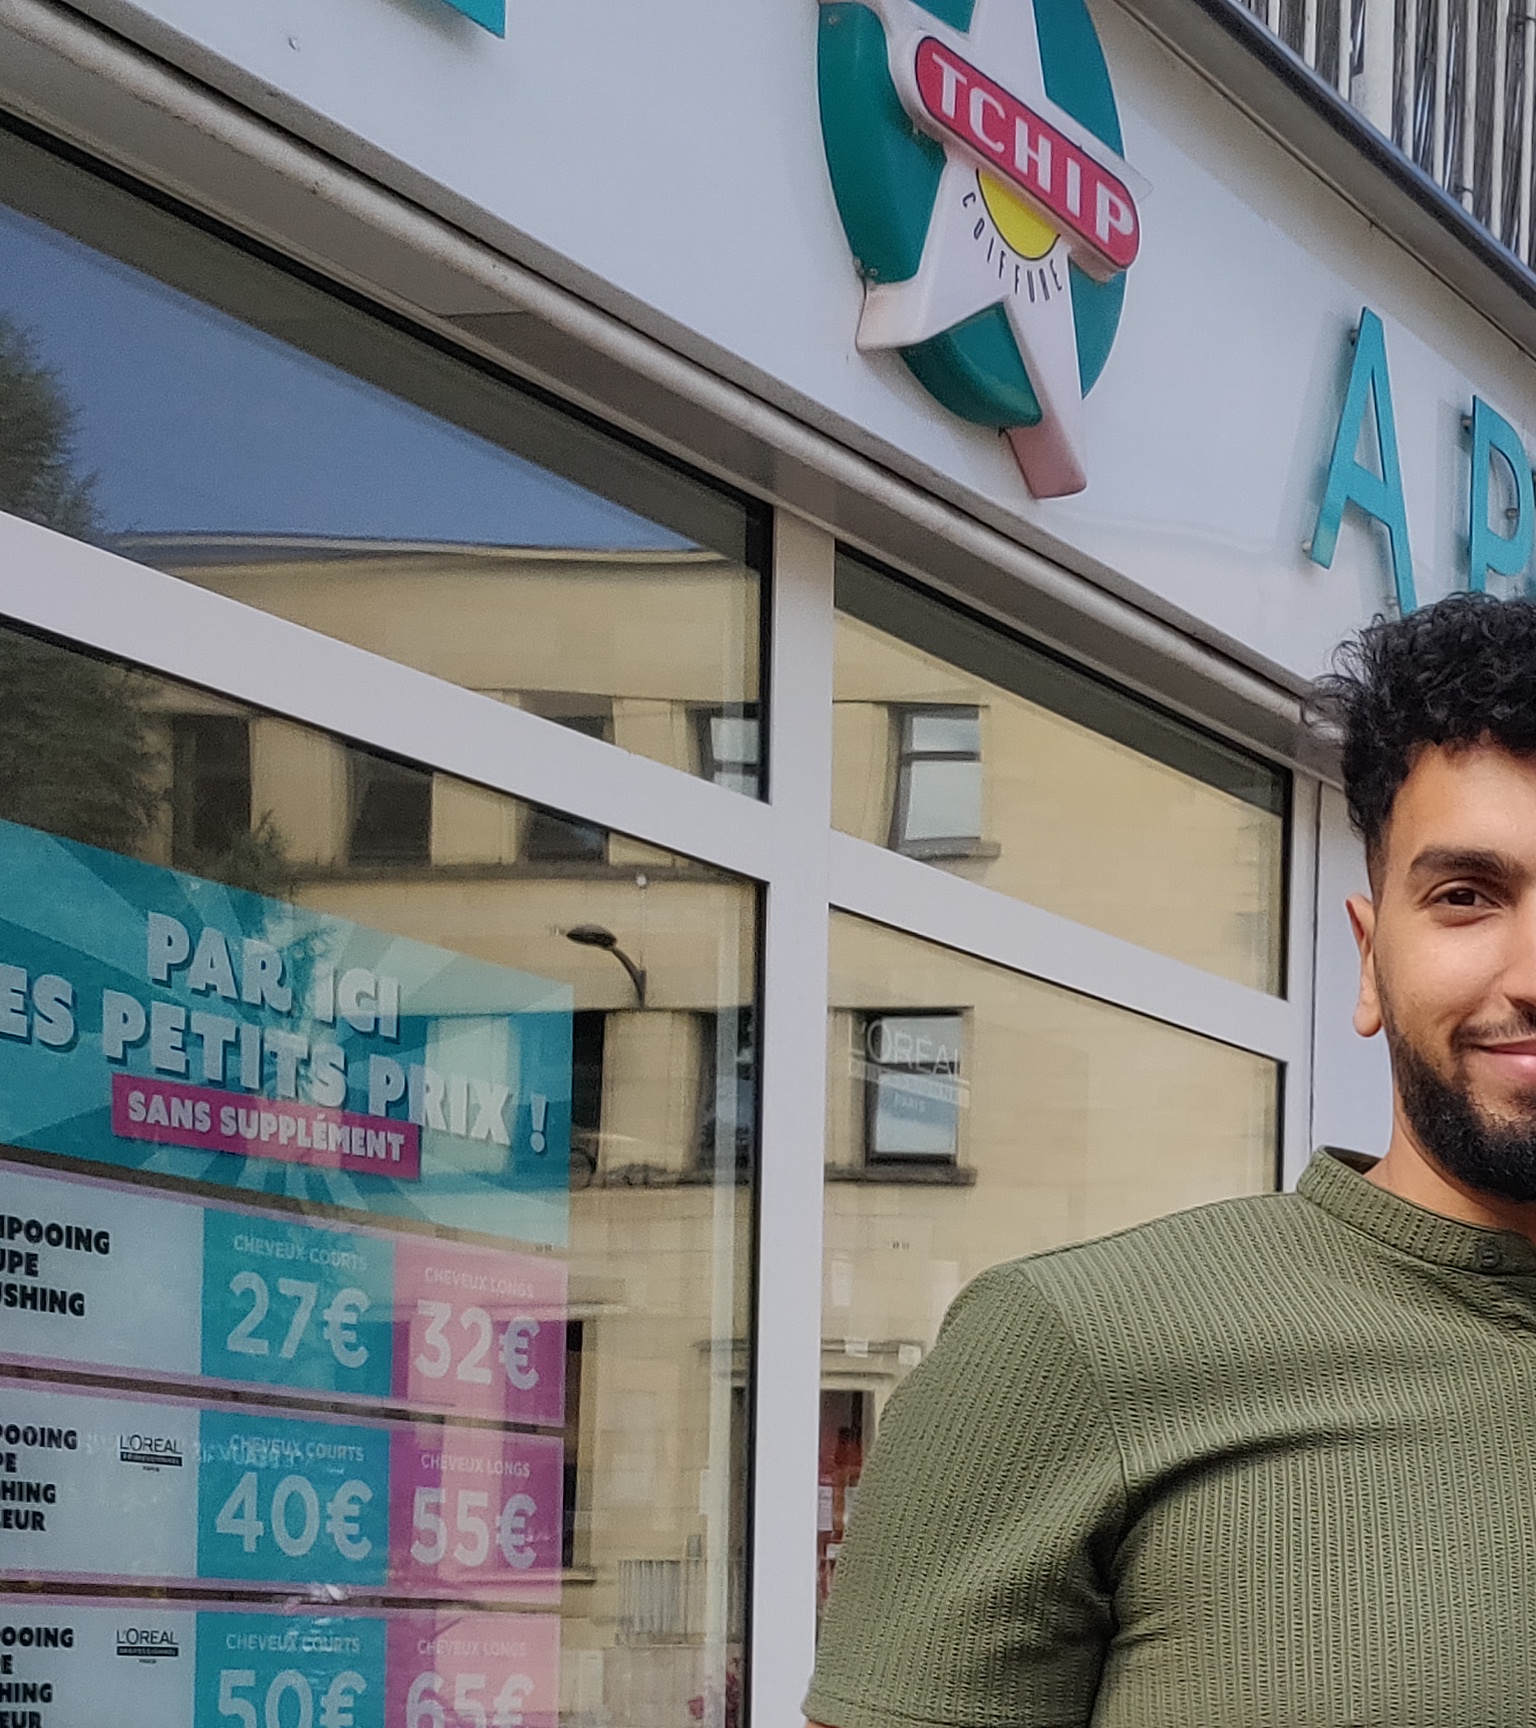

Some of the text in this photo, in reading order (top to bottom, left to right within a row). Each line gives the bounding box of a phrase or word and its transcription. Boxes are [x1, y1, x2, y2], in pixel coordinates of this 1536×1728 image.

[932, 53, 1134, 245] TCHIP
[962, 190, 1064, 303] COIFFURE
[1309, 306, 1419, 616] A
[148, 910, 401, 1038] PAR ICI
[102, 989, 347, 1108] PETITS
[368, 1054, 510, 1145] PRIX
[127, 1091, 404, 1162] SANS SUPPLÉMENT
[0, 1215, 110, 1255] POOING
[234, 1235, 367, 1271] CHEVEUX COURTS
[226, 1271, 369, 1368] 27€
[425, 1268, 533, 1299] CHEVEUX LONGS
[414, 1299, 541, 1390] 32€
[0, 1425, 77, 1449] OOING
[421, 1454, 530, 1478] CHEVEUX LONGS
[0, 1509, 46, 1531] EUR
[215, 1472, 373, 1560] 40€
[410, 1487, 537, 1569] 55€
